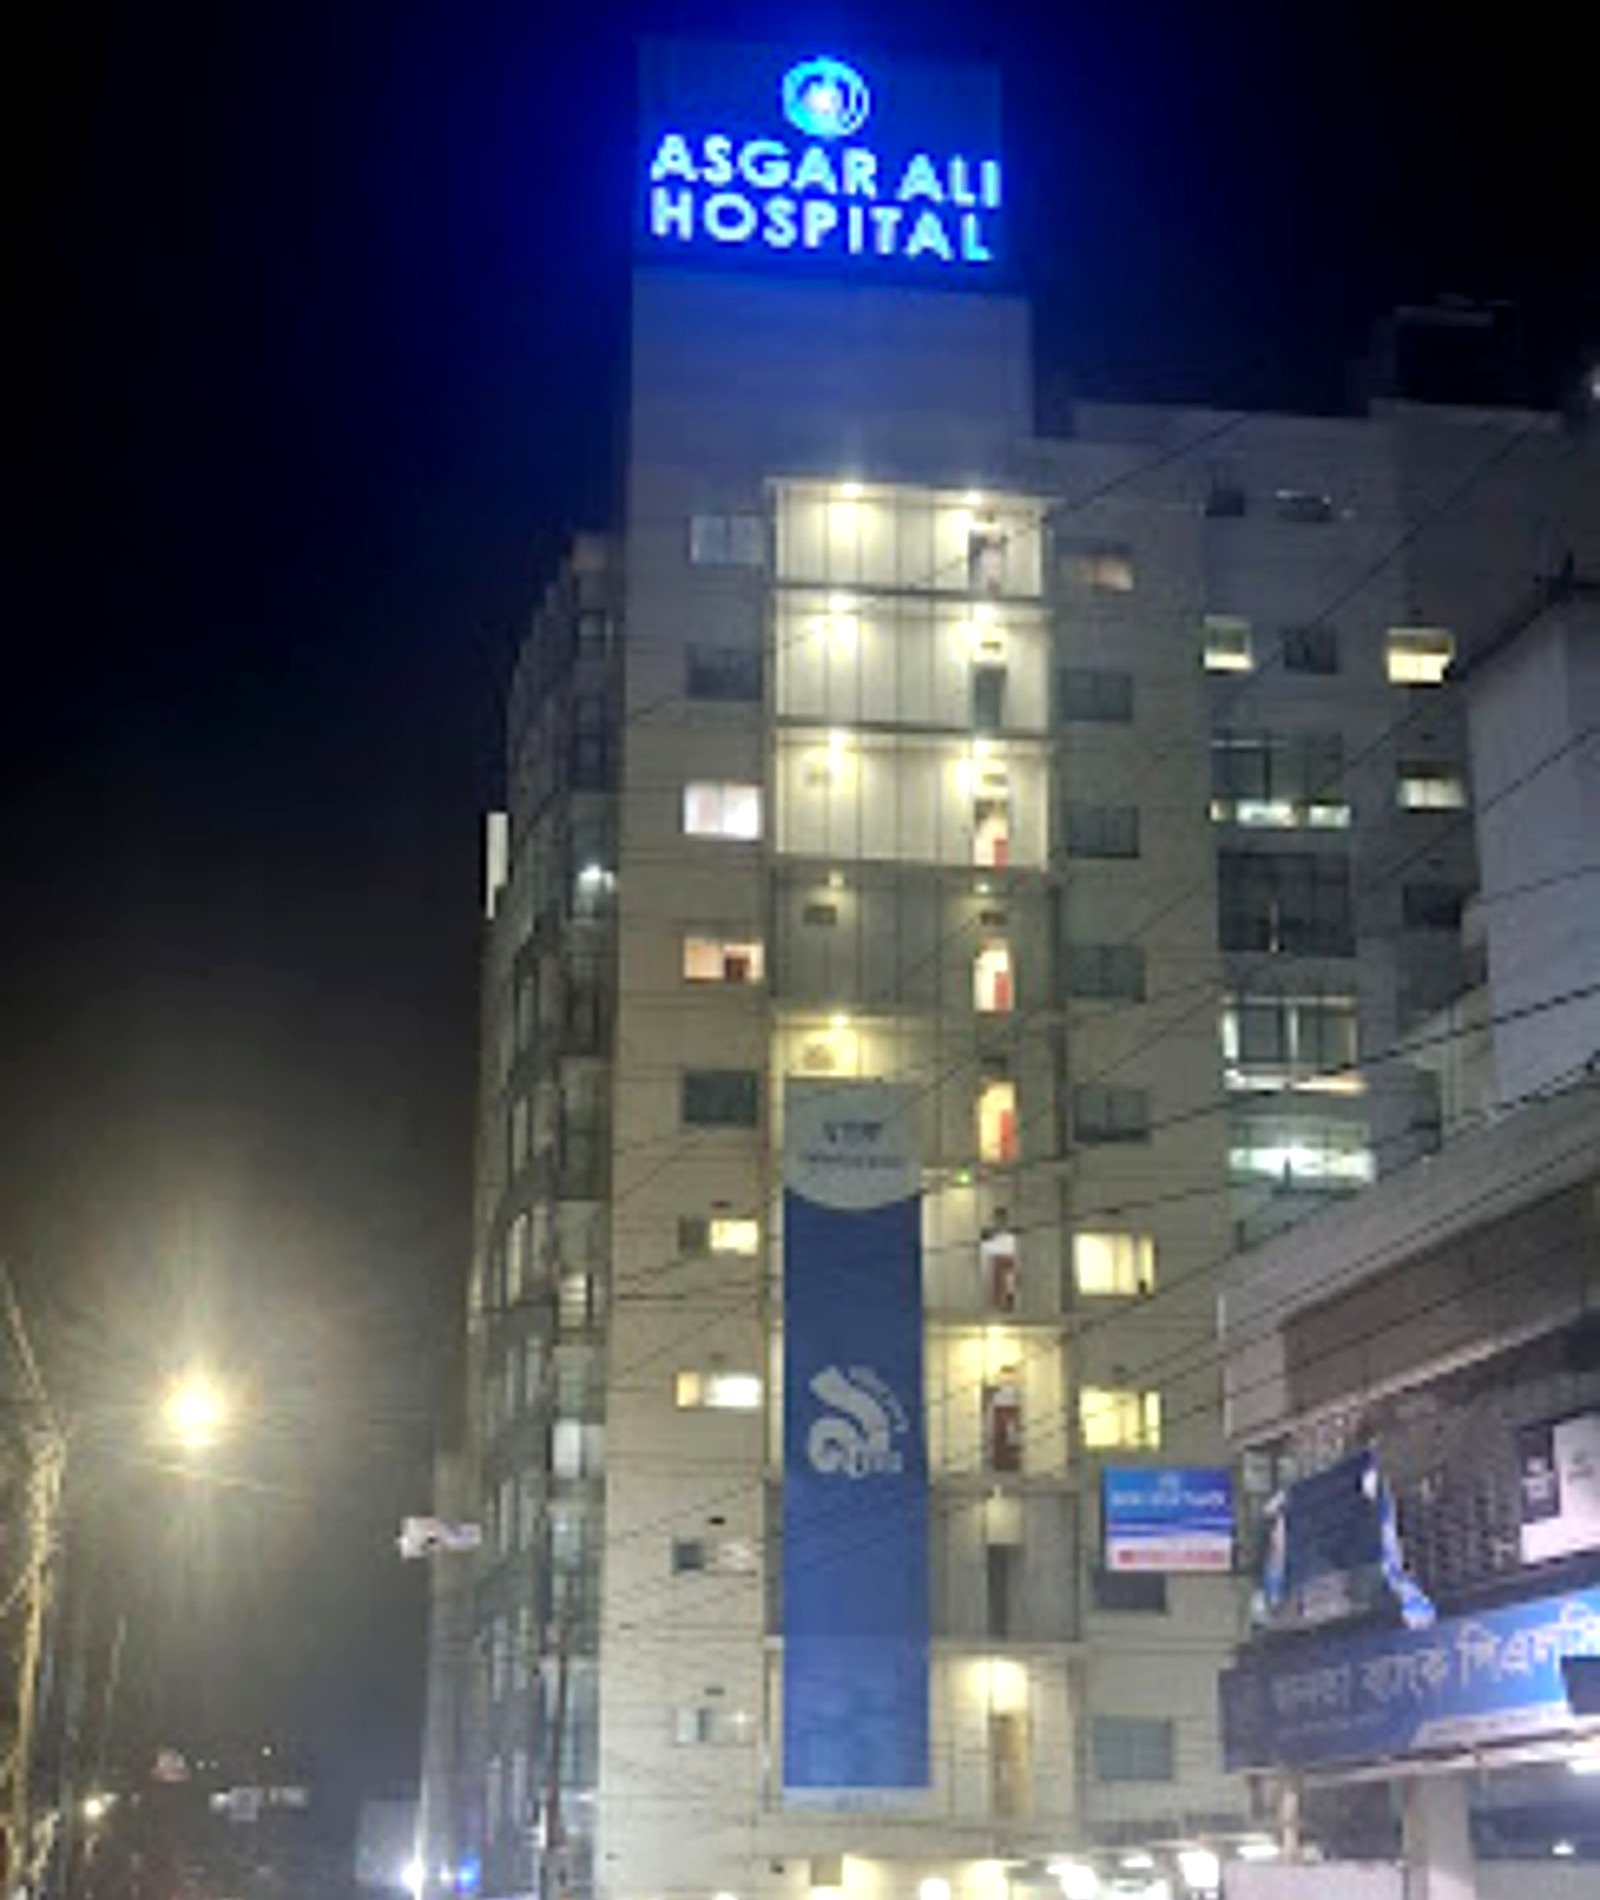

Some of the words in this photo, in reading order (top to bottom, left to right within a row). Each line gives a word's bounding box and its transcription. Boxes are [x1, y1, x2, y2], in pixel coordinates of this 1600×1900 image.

[650, 133, 878, 200] ASGAR
[899, 153, 1001, 209] ALI
[650, 187, 994, 262] HOSPITAL
